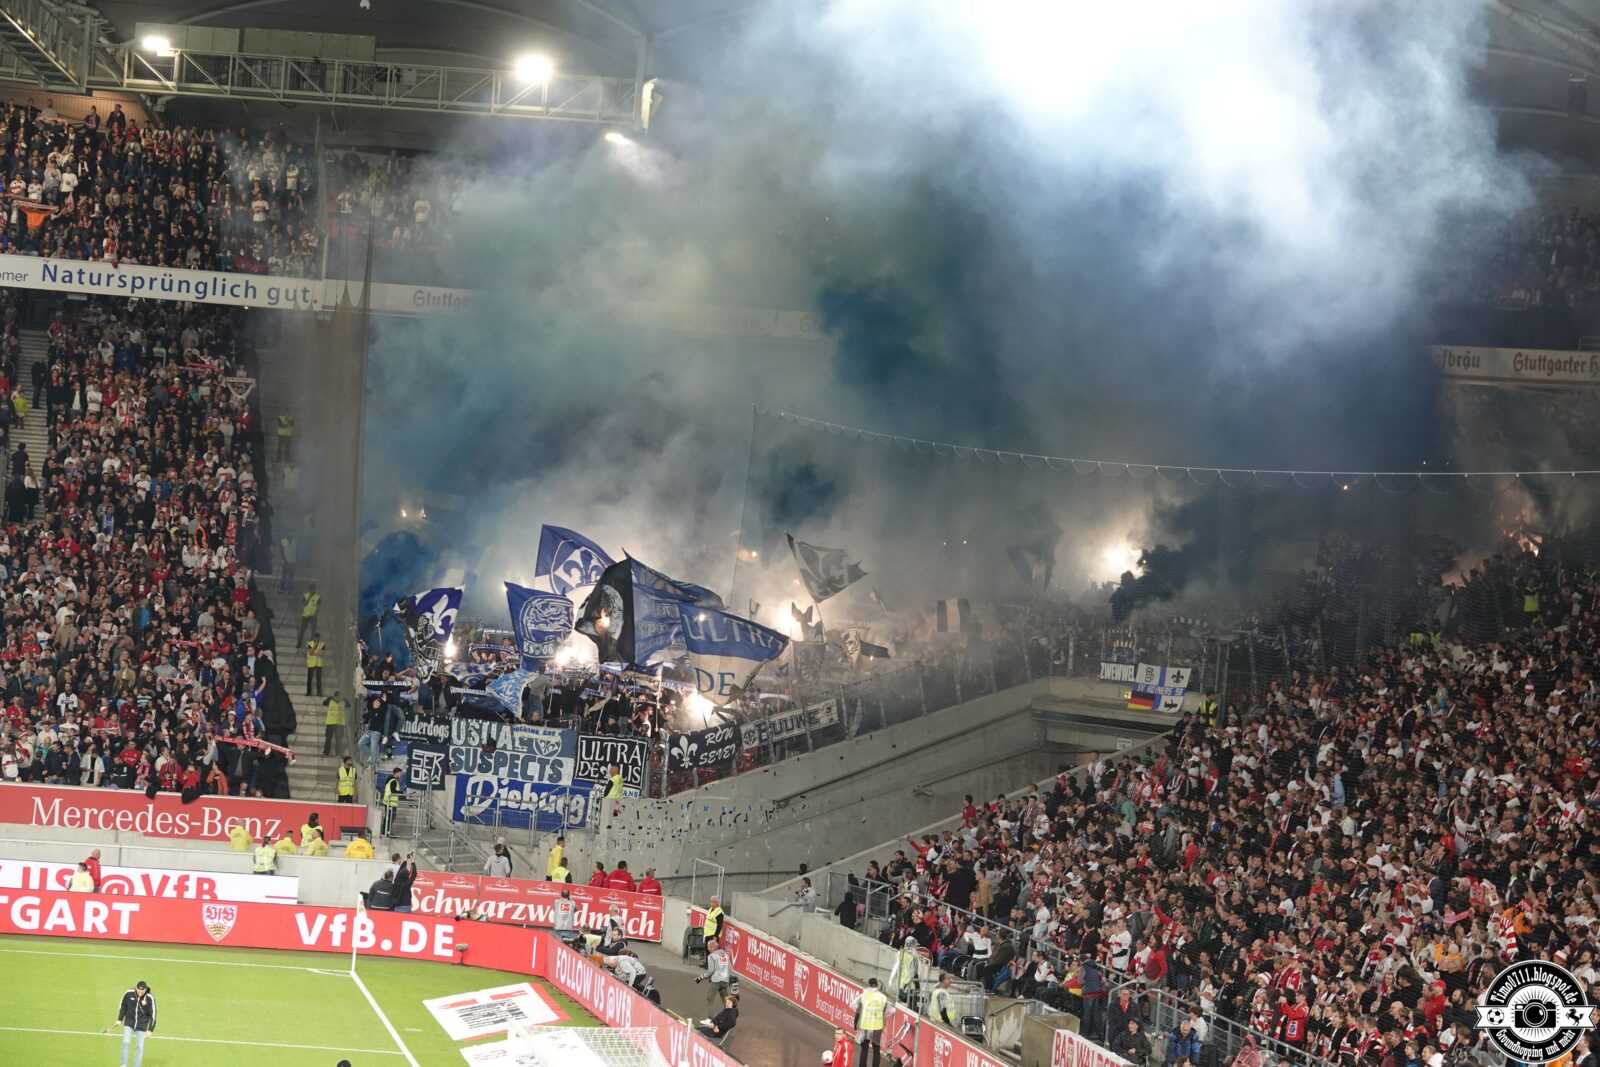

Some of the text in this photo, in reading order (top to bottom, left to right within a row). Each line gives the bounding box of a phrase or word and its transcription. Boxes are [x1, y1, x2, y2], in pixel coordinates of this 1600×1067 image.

[42, 264, 257, 299] Natursprünglich
[267, 284, 318, 305] gut.
[1513, 351, 1600, 378] Stuttgarter H
[450, 747, 564, 783] SUSPECTS
[31, 797, 282, 841] Mercedes-Benz
[295, 912, 455, 957] VfB.DE
[555, 947, 632, 1028] FOLLOW US @VfB
